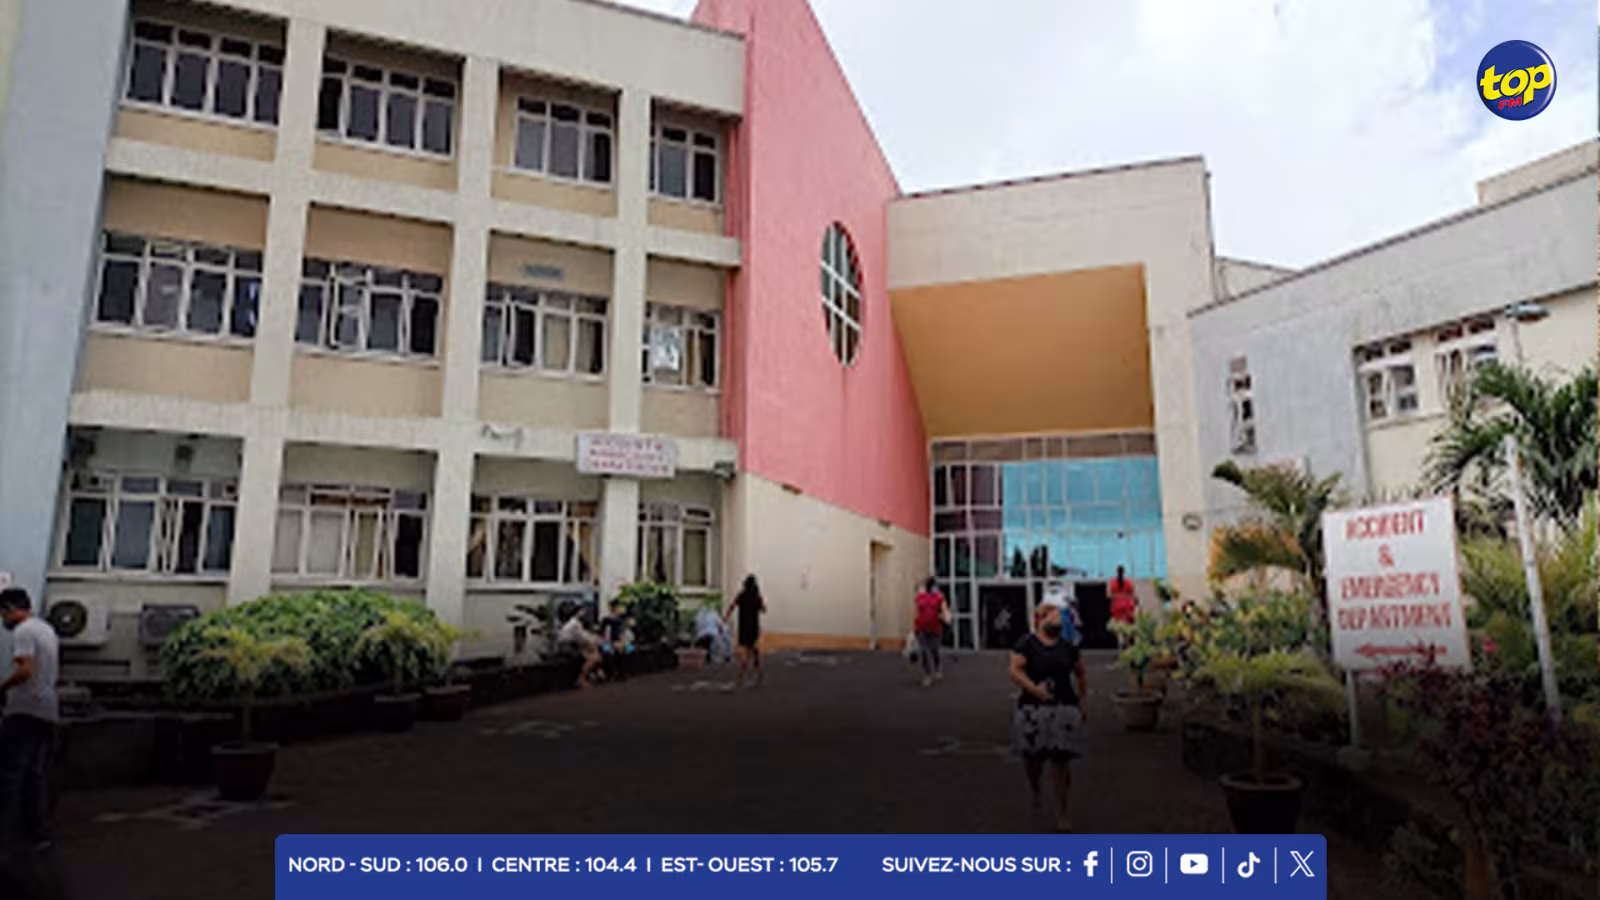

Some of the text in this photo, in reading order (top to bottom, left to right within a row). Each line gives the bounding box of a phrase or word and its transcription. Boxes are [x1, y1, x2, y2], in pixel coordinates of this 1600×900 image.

[1346, 510, 1425, 541] ACCIDENT
[1378, 544, 1396, 568] &
[1340, 572, 1441, 601] EMERGENCY
[1338, 601, 1451, 631] DEPARTMENT
